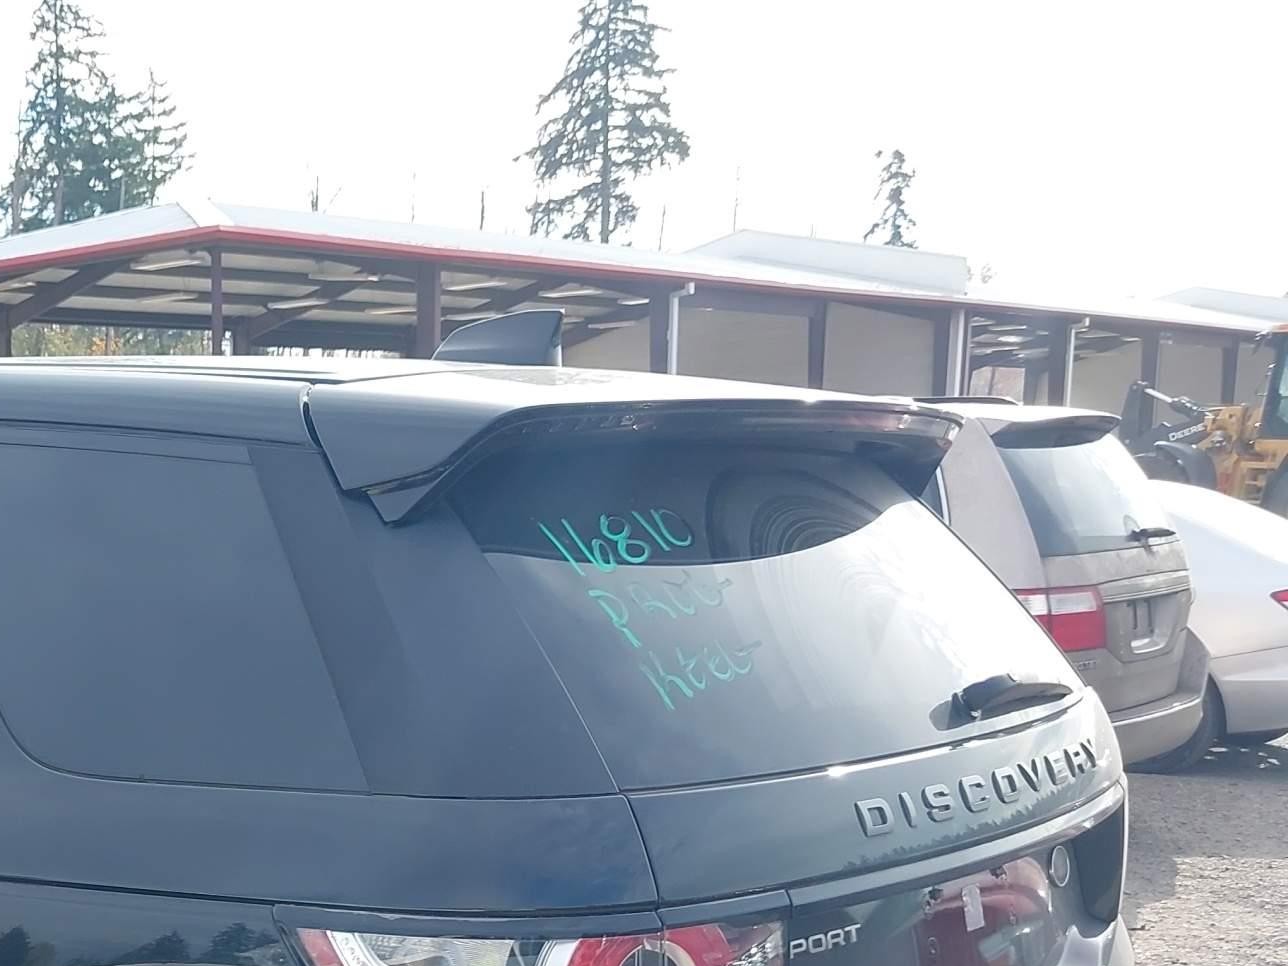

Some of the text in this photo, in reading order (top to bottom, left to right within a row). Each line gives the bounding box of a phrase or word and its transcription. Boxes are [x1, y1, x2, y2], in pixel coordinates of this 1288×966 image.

[1168, 422, 1205, 441] DEERE
[538, 508, 695, 577] 16810
[854, 738, 1099, 838] DISCOVERY
[789, 923, 862, 960] PORT
